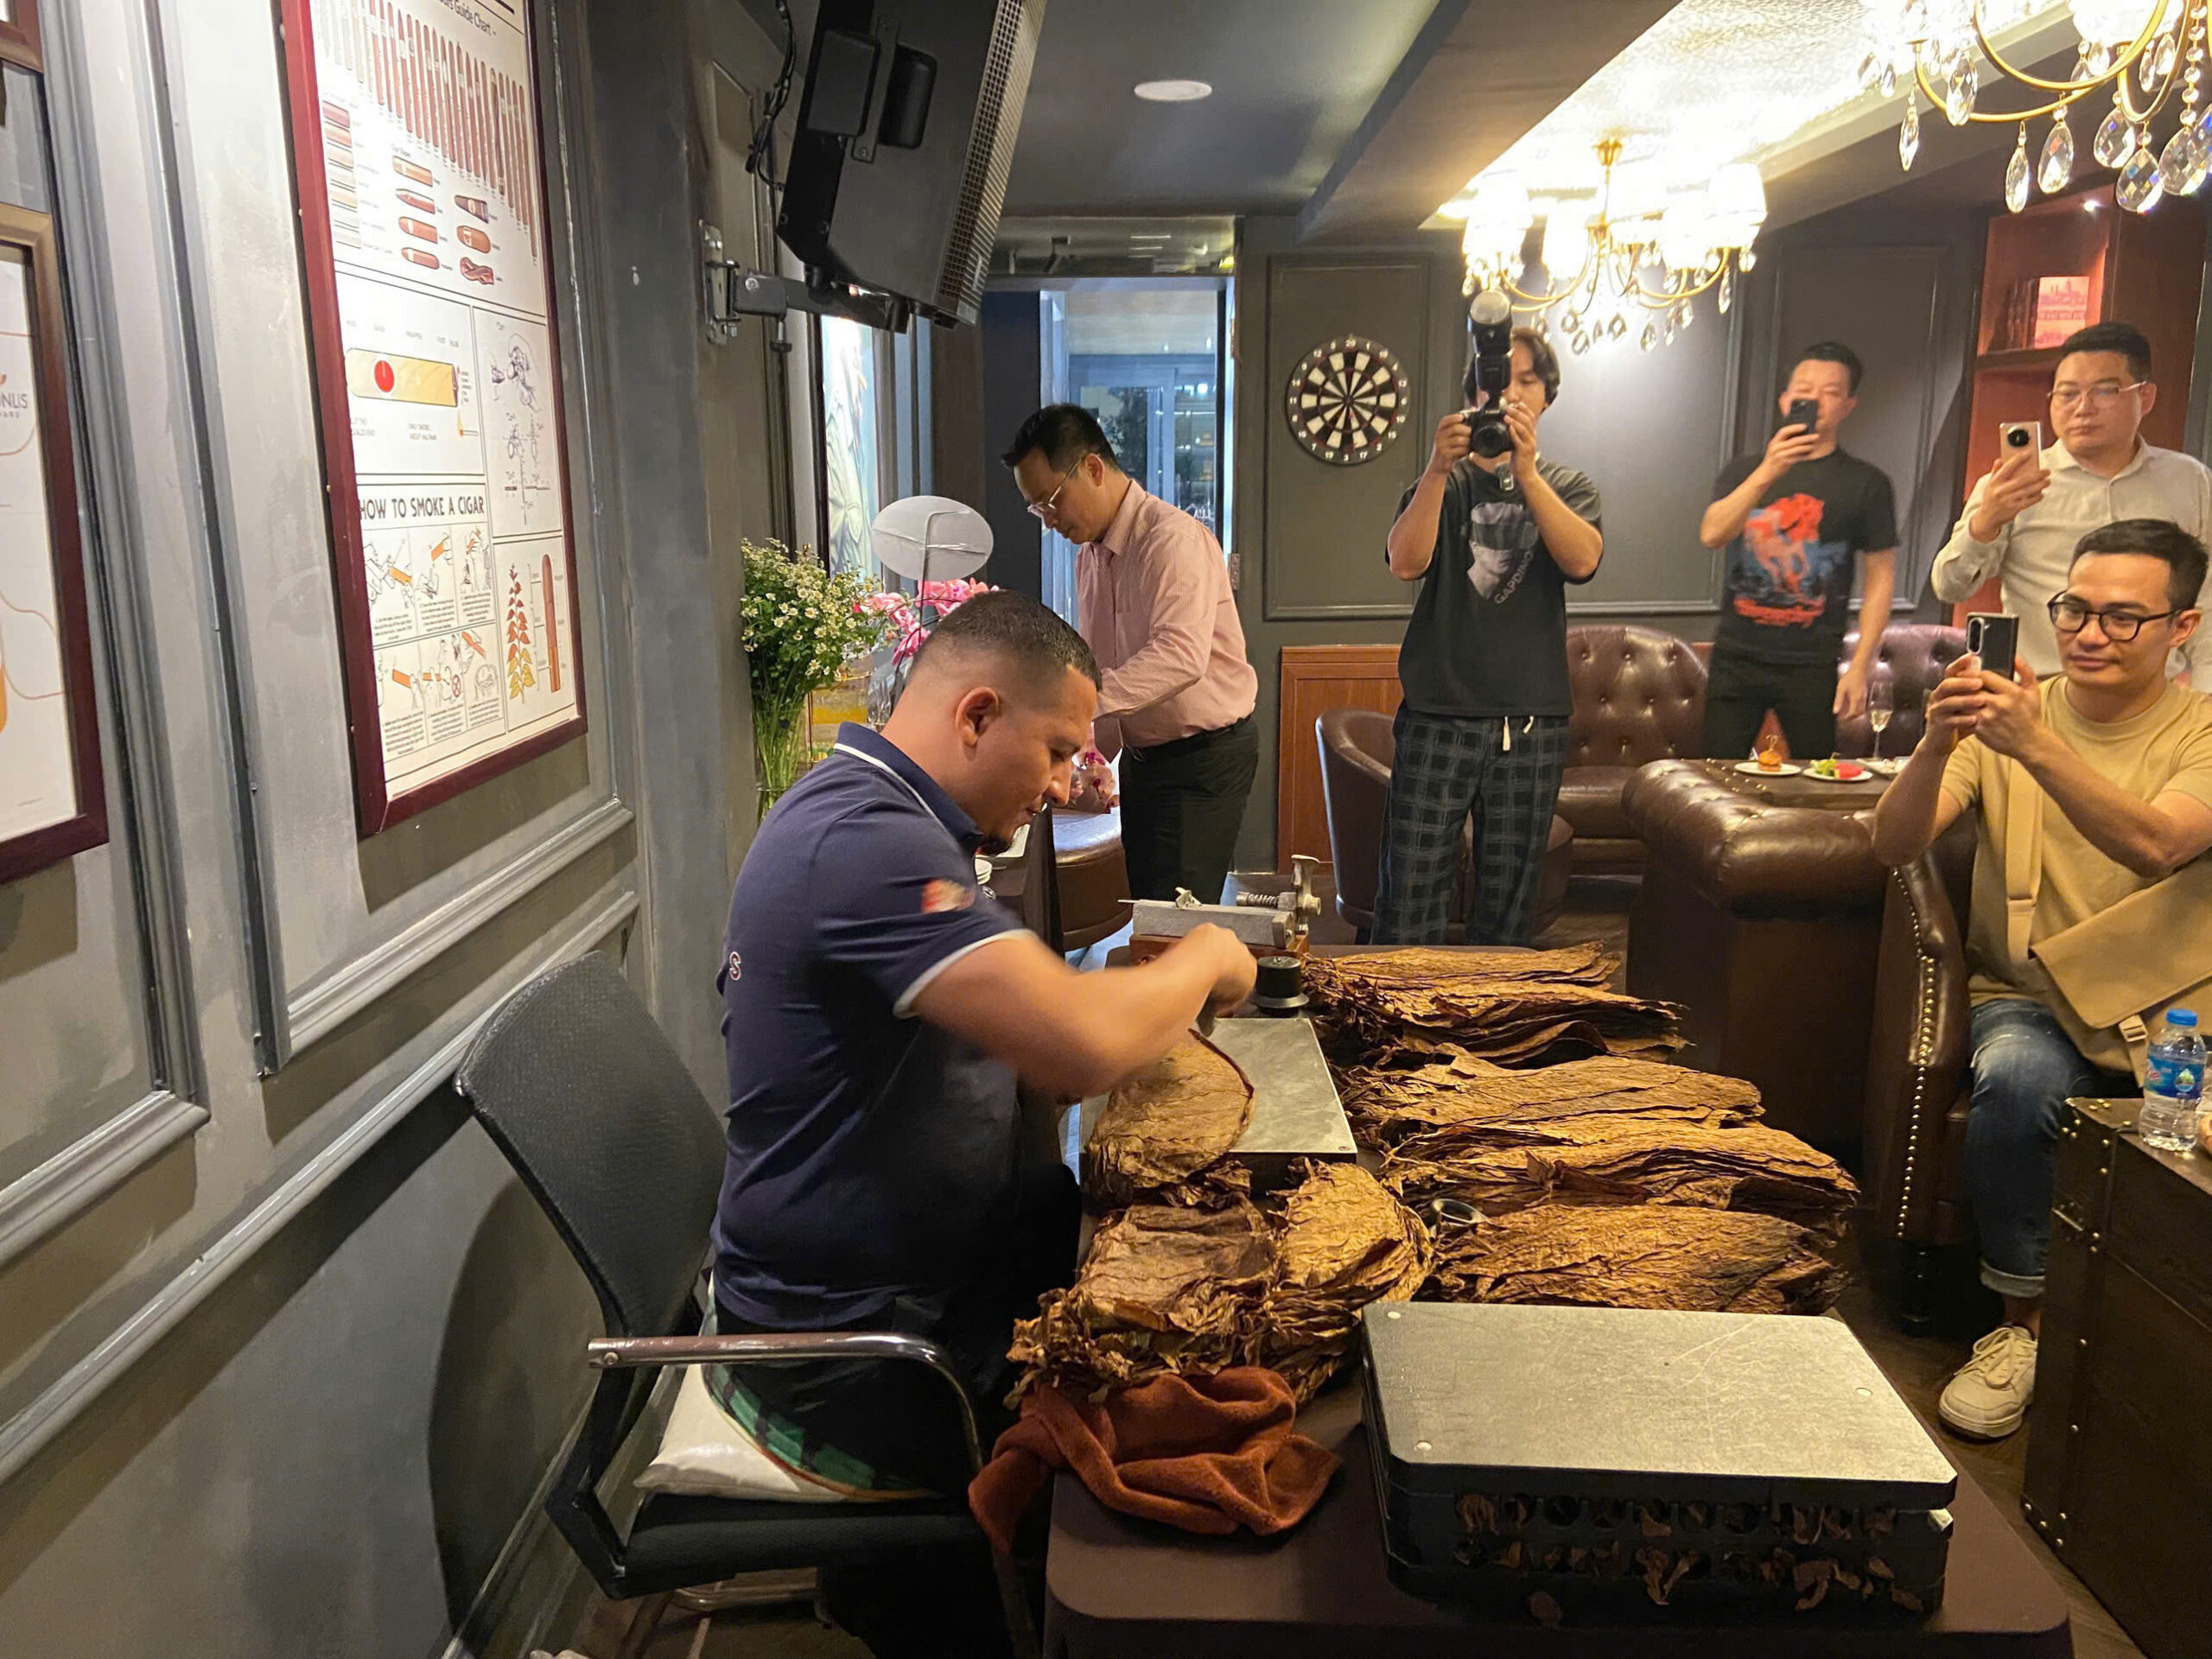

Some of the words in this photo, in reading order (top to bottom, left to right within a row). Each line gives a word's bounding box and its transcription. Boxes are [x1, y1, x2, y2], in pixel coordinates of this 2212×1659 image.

[0, 392, 29, 410] NUS
[359, 499, 386, 519] HOW
[391, 498, 407, 518] TO
[410, 497, 445, 517] SMOKE
[448, 496, 455, 515] A
[457, 495, 485, 515] CIGAR
